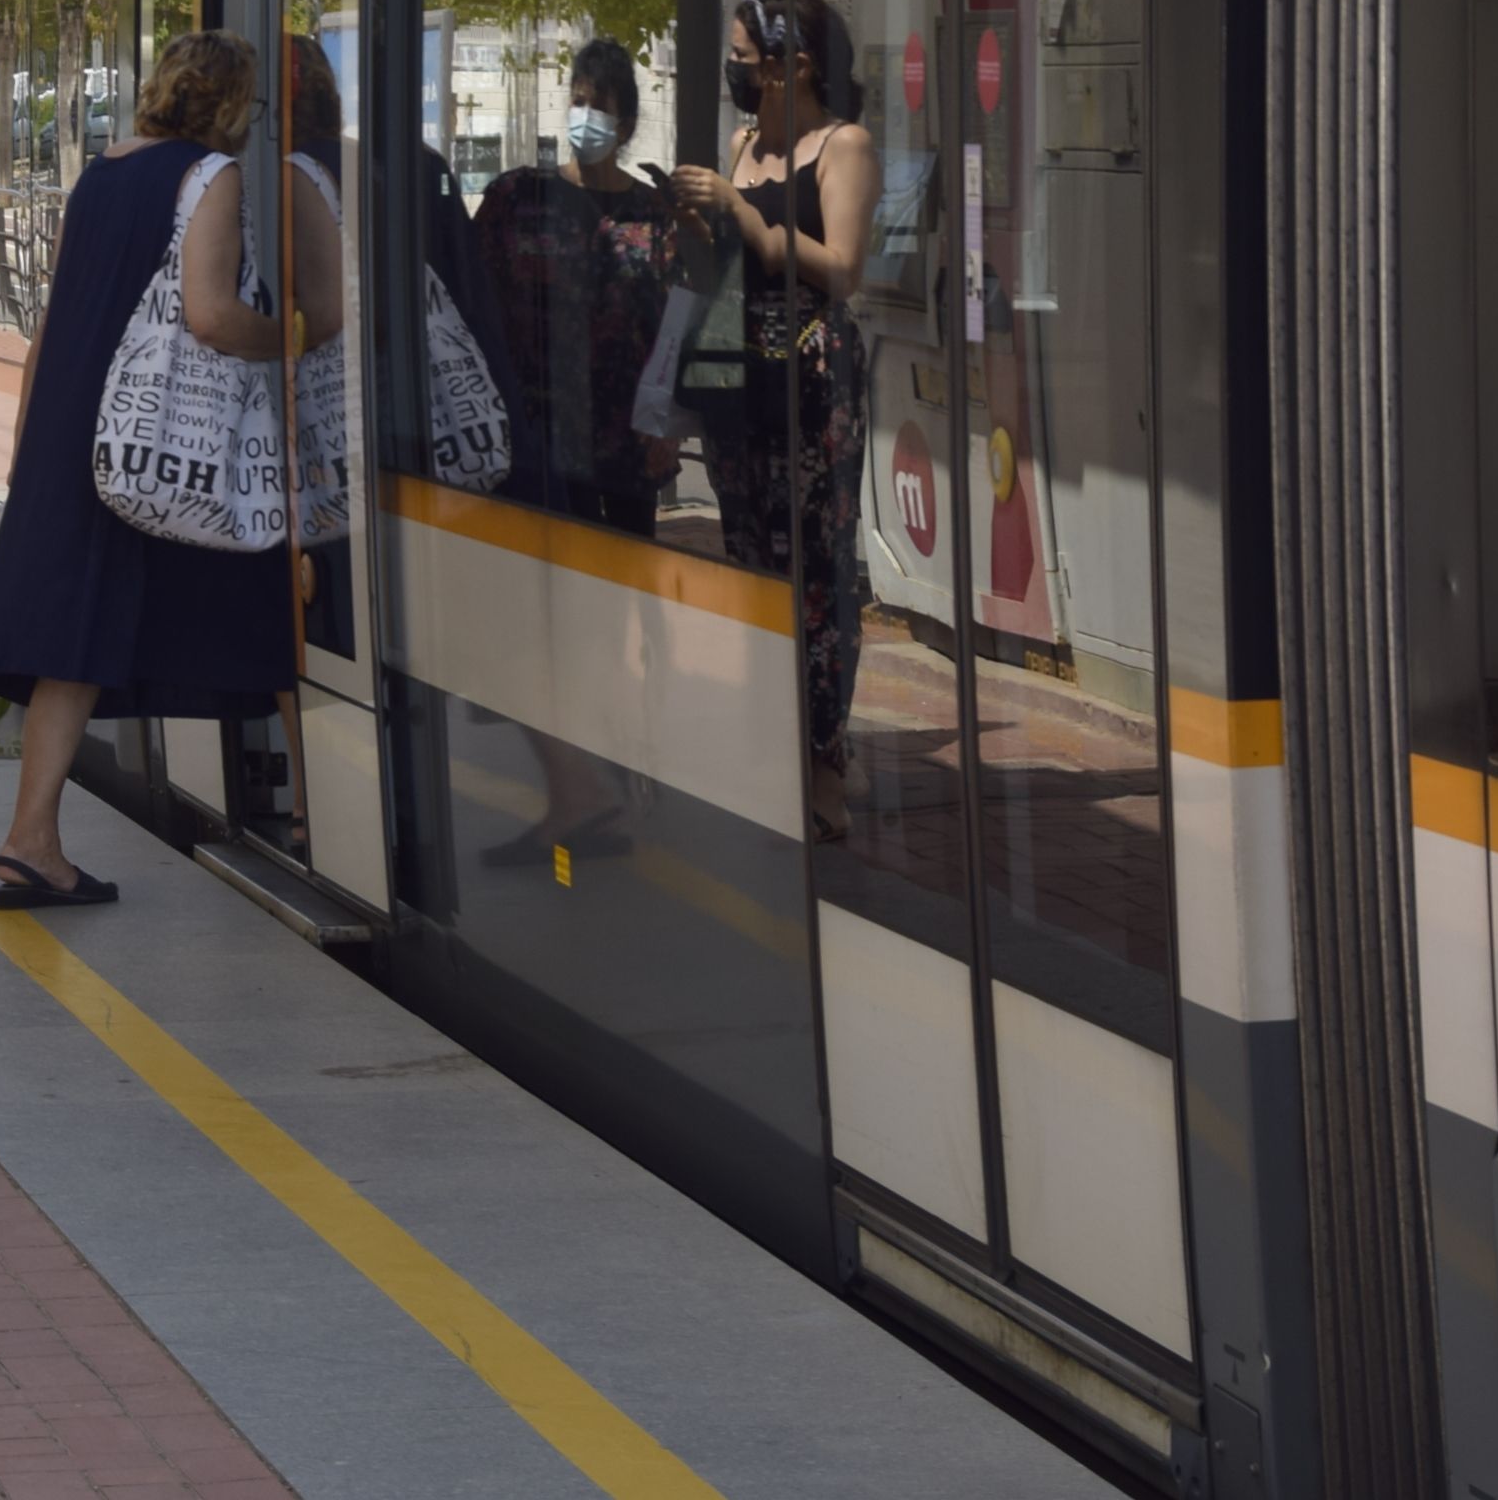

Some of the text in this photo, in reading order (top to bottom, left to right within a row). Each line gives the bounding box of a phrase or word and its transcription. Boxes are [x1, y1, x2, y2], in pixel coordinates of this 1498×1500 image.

[118, 371, 228, 403] RULES FORGIVE
[164, 407, 225, 436] slowly
[161, 428, 223, 458] truly
